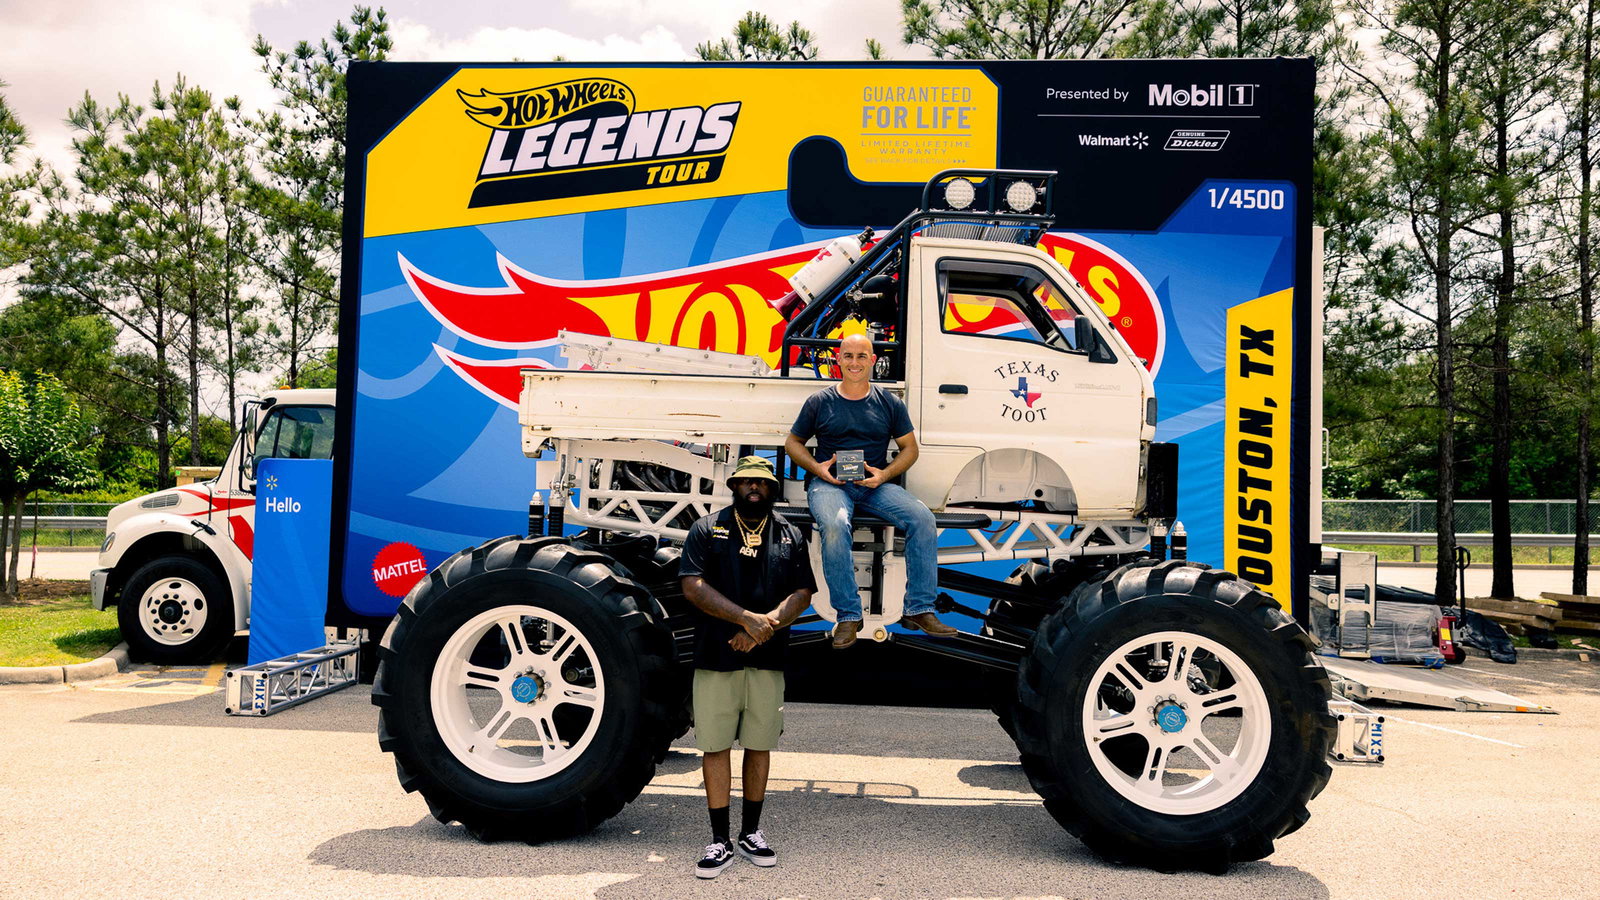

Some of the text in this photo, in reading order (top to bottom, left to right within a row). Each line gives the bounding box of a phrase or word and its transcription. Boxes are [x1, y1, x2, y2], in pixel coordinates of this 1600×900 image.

[863, 86, 972, 102] GUARANTEED
[1046, 88, 1110, 100] Presented
[1114, 88, 1129, 102] by
[1149, 84, 1223, 106] Mobil
[498, 94, 550, 126] HOT
[862, 105, 908, 129] FOR
[481, 102, 740, 176] LEGENDS
[1079, 134, 1131, 146] Walmart
[1170, 139, 1219, 148] Dickies
[646, 161, 710, 185] TOUR
[1208, 187, 1285, 210] 1/4500
[994, 361, 1059, 382] TEXAS
[1001, 403, 1047, 423] TOOT
[1237, 324, 1278, 594] OUSTON, TX
[265, 497, 302, 513] Hello
[373, 558, 428, 582] MATTEL
[254, 678, 266, 710] MIX3
[1370, 722, 1383, 757] MIX3
